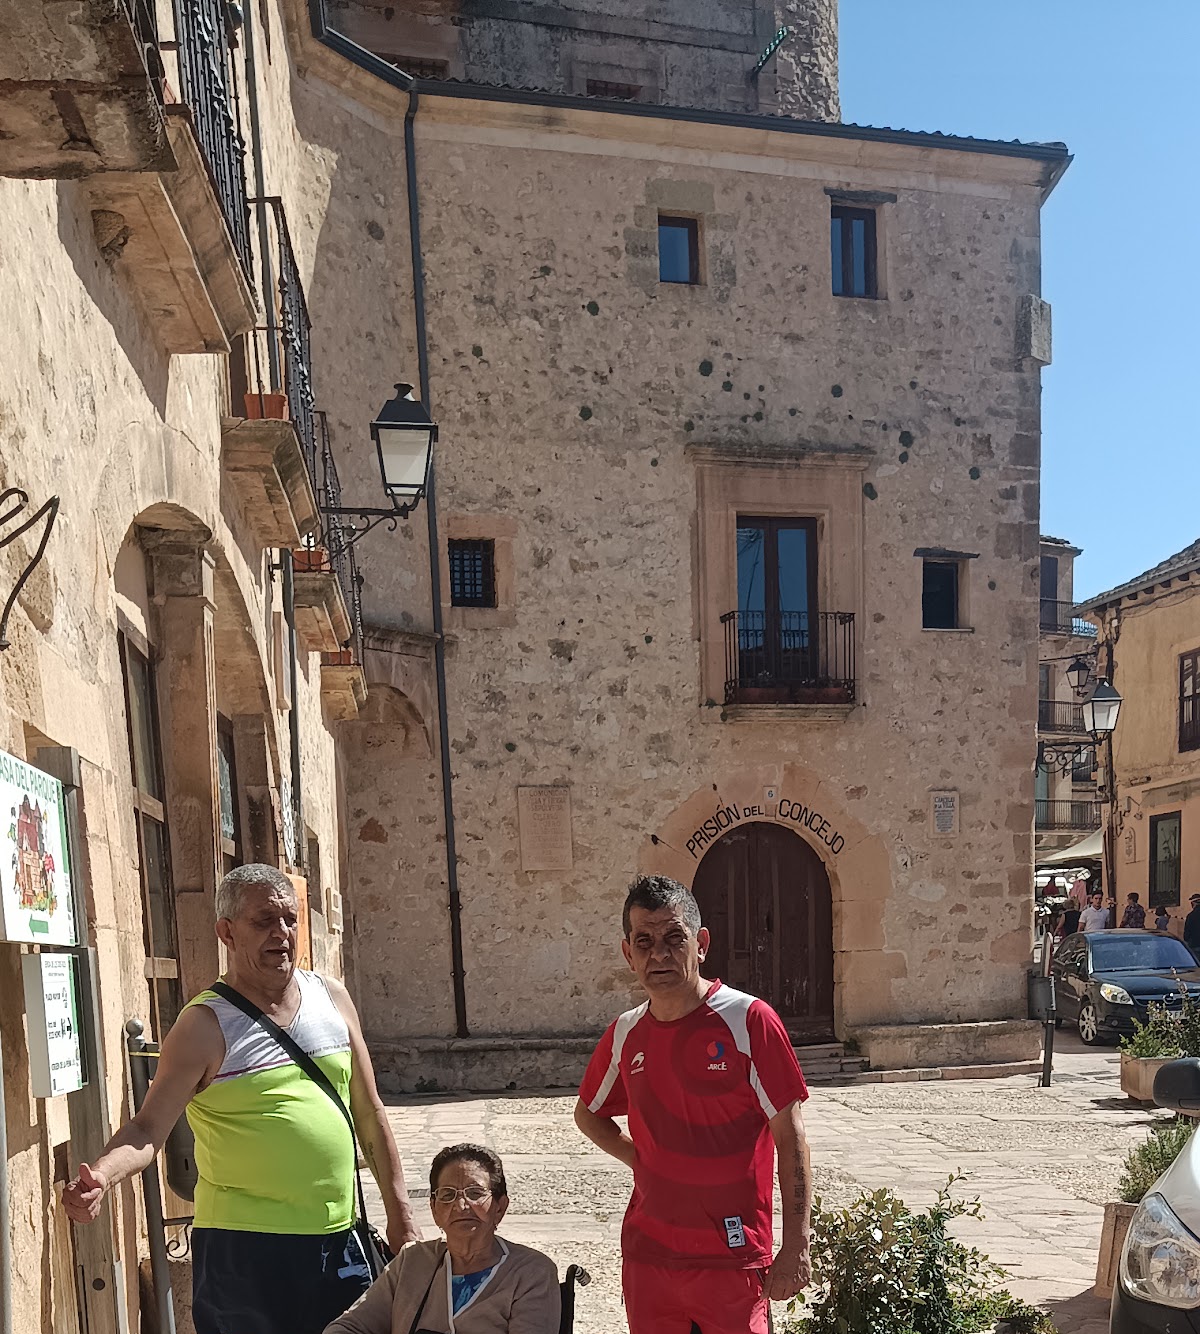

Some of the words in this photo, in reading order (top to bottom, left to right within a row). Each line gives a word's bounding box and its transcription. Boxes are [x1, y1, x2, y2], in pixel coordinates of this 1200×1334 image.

[0, 755, 15, 785] ASA
[15, 762, 30, 791] DEL
[30, 770, 56, 803] PARQUE
[767, 790, 774, 798] 6
[685, 803, 741, 859] PRISIÓN
[743, 805, 764, 818] DEL
[778, 799, 845, 855] CONCEJO
